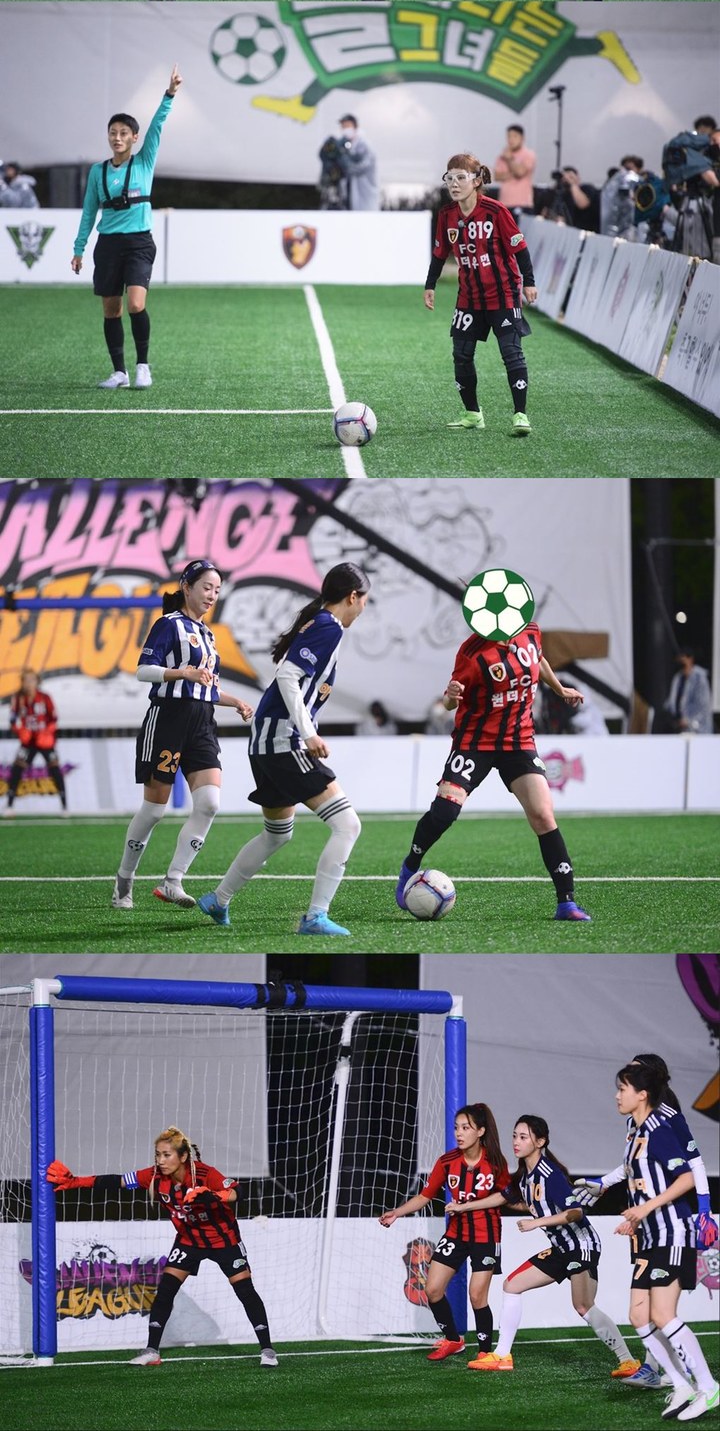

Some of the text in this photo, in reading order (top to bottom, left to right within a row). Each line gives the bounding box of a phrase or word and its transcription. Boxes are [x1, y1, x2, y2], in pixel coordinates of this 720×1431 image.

[397, 10, 541, 87] 그녀들
[467, 220, 494, 240] 819
[459, 243, 477, 254] FC
[455, 252, 492, 270] 더우먼
[517, 643, 539, 668] 02
[510, 674, 532, 689] FC
[157, 749, 181, 774] 23
[450, 754, 476, 781] 02
[475, 1173, 494, 1190] 23
[435, 1237, 456, 1257] 23
[633, 1258, 649, 1281] 7
